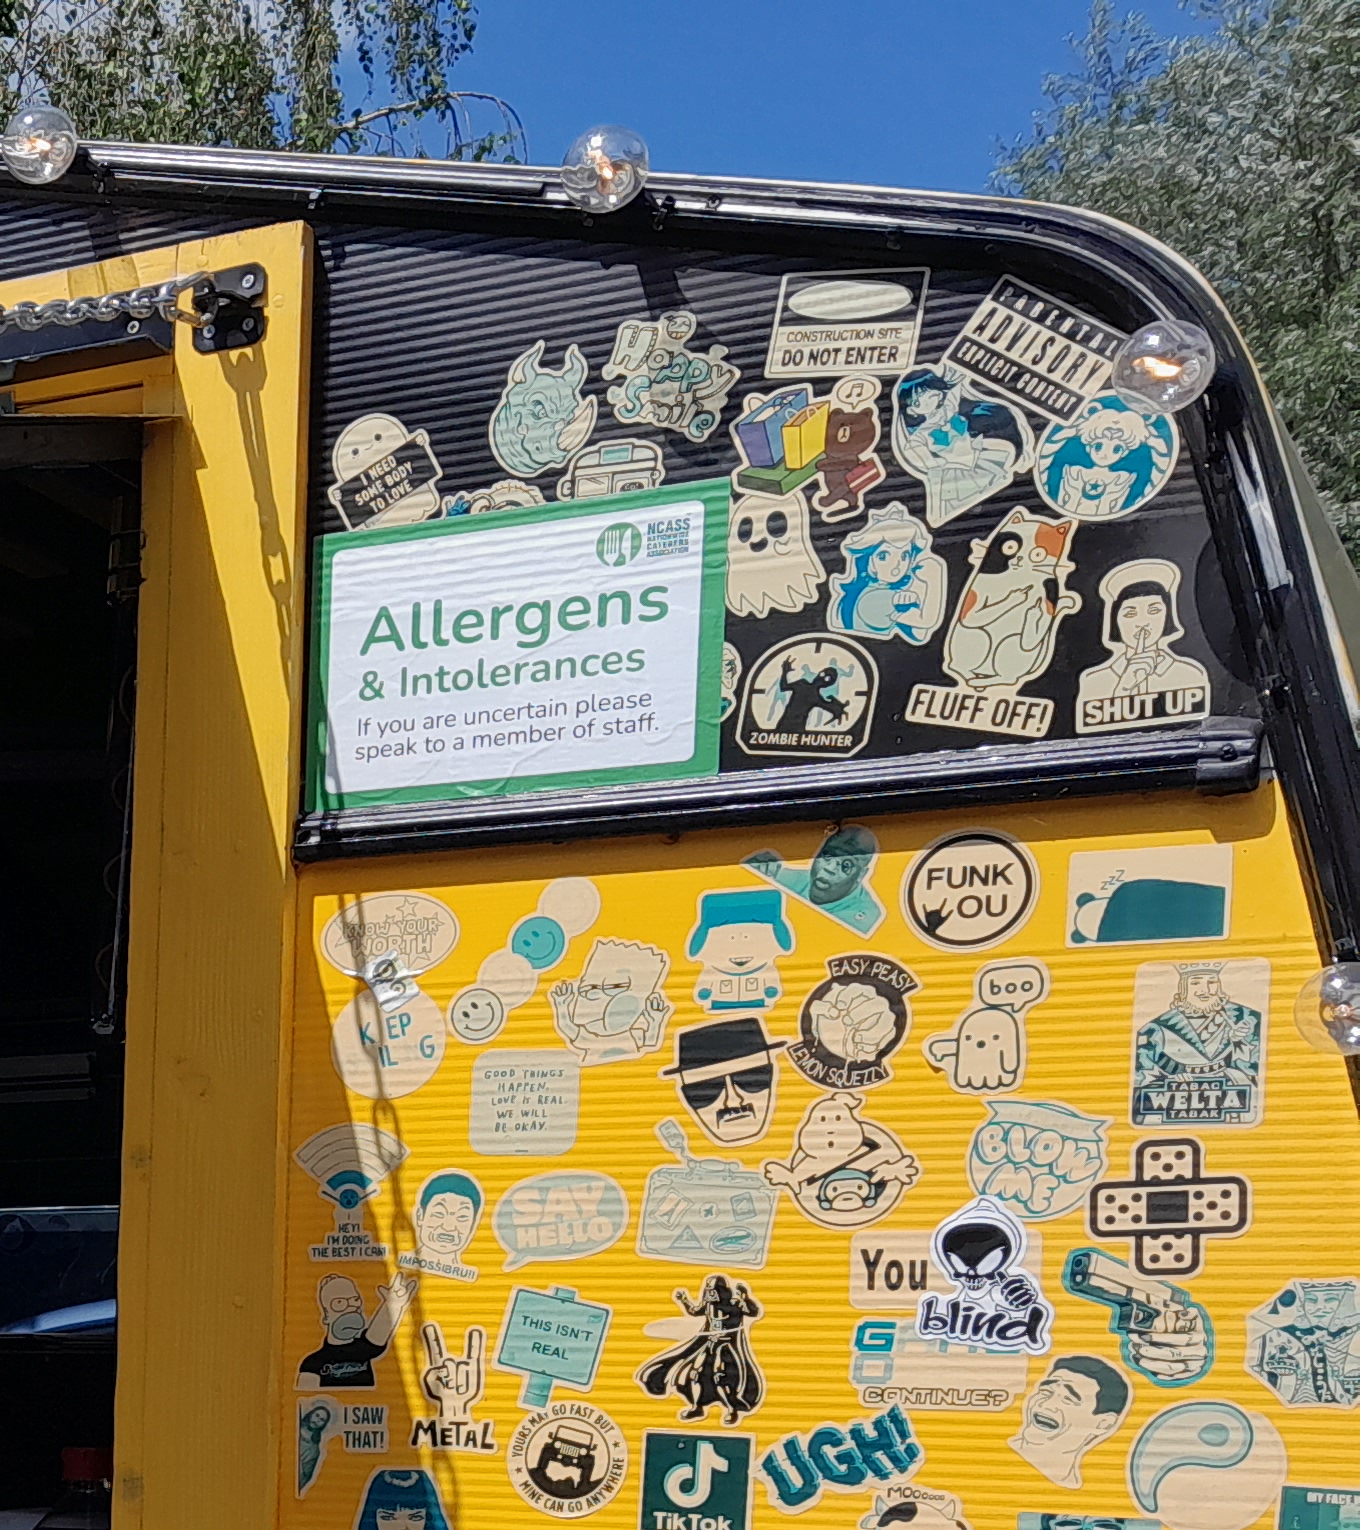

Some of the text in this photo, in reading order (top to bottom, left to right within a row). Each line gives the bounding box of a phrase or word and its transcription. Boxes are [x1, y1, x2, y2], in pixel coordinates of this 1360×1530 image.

[786, 326, 902, 343] CONSTRUCTION SITE
[999, 286, 1118, 356] PARENTAL
[782, 344, 898, 366] DO NOT ENTER
[972, 306, 1105, 390] ADVISORY
[958, 341, 1077, 413] EXPLICIT CONTENT
[355, 462, 413, 506] SOME BODY
[360, 455, 396, 486] I NEED
[370, 482, 412, 513] TO LOVE
[647, 519, 691, 535] NCASS
[360, 585, 670, 656] Allergens
[358, 649, 645, 701] & Intolerances
[357, 692, 652, 739] If you are uncertain please
[910, 689, 1046, 732] FLUFF OFF!
[1083, 689, 1204, 724] SHUT UP
[355, 715, 659, 763] speak to a member of staff.
[750, 732, 853, 747] ZOMBIE HUNTER
[926, 863, 1015, 890] FUNK
[344, 918, 438, 940] KNOW YOUR
[351, 934, 431, 956] WORTH
[830, 961, 916, 992] EASY PEASY
[989, 977, 1033, 995] boo
[484, 1069, 564, 1079] GOOD THINGS
[491, 1095, 517, 1106] LOVE
[497, 1109, 547, 1118] WE WILL
[1147, 1091, 1244, 1110] WELTA
[1170, 1109, 1219, 1119] TABAK
[979, 1125, 1104, 1182] BLOW
[982, 1164, 1055, 1202] ME
[861, 1249, 927, 1292] You
[521, 1315, 593, 1341] THIS ISN'T
[923, 1299, 1042, 1344] blind
[531, 1341, 569, 1360] REAL
[863, 1388, 1009, 1406] CONTINUE?
[344, 1408, 384, 1424] I SAW
[344, 1430, 384, 1449] THAT!
[761, 1406, 920, 1508] UGH!
